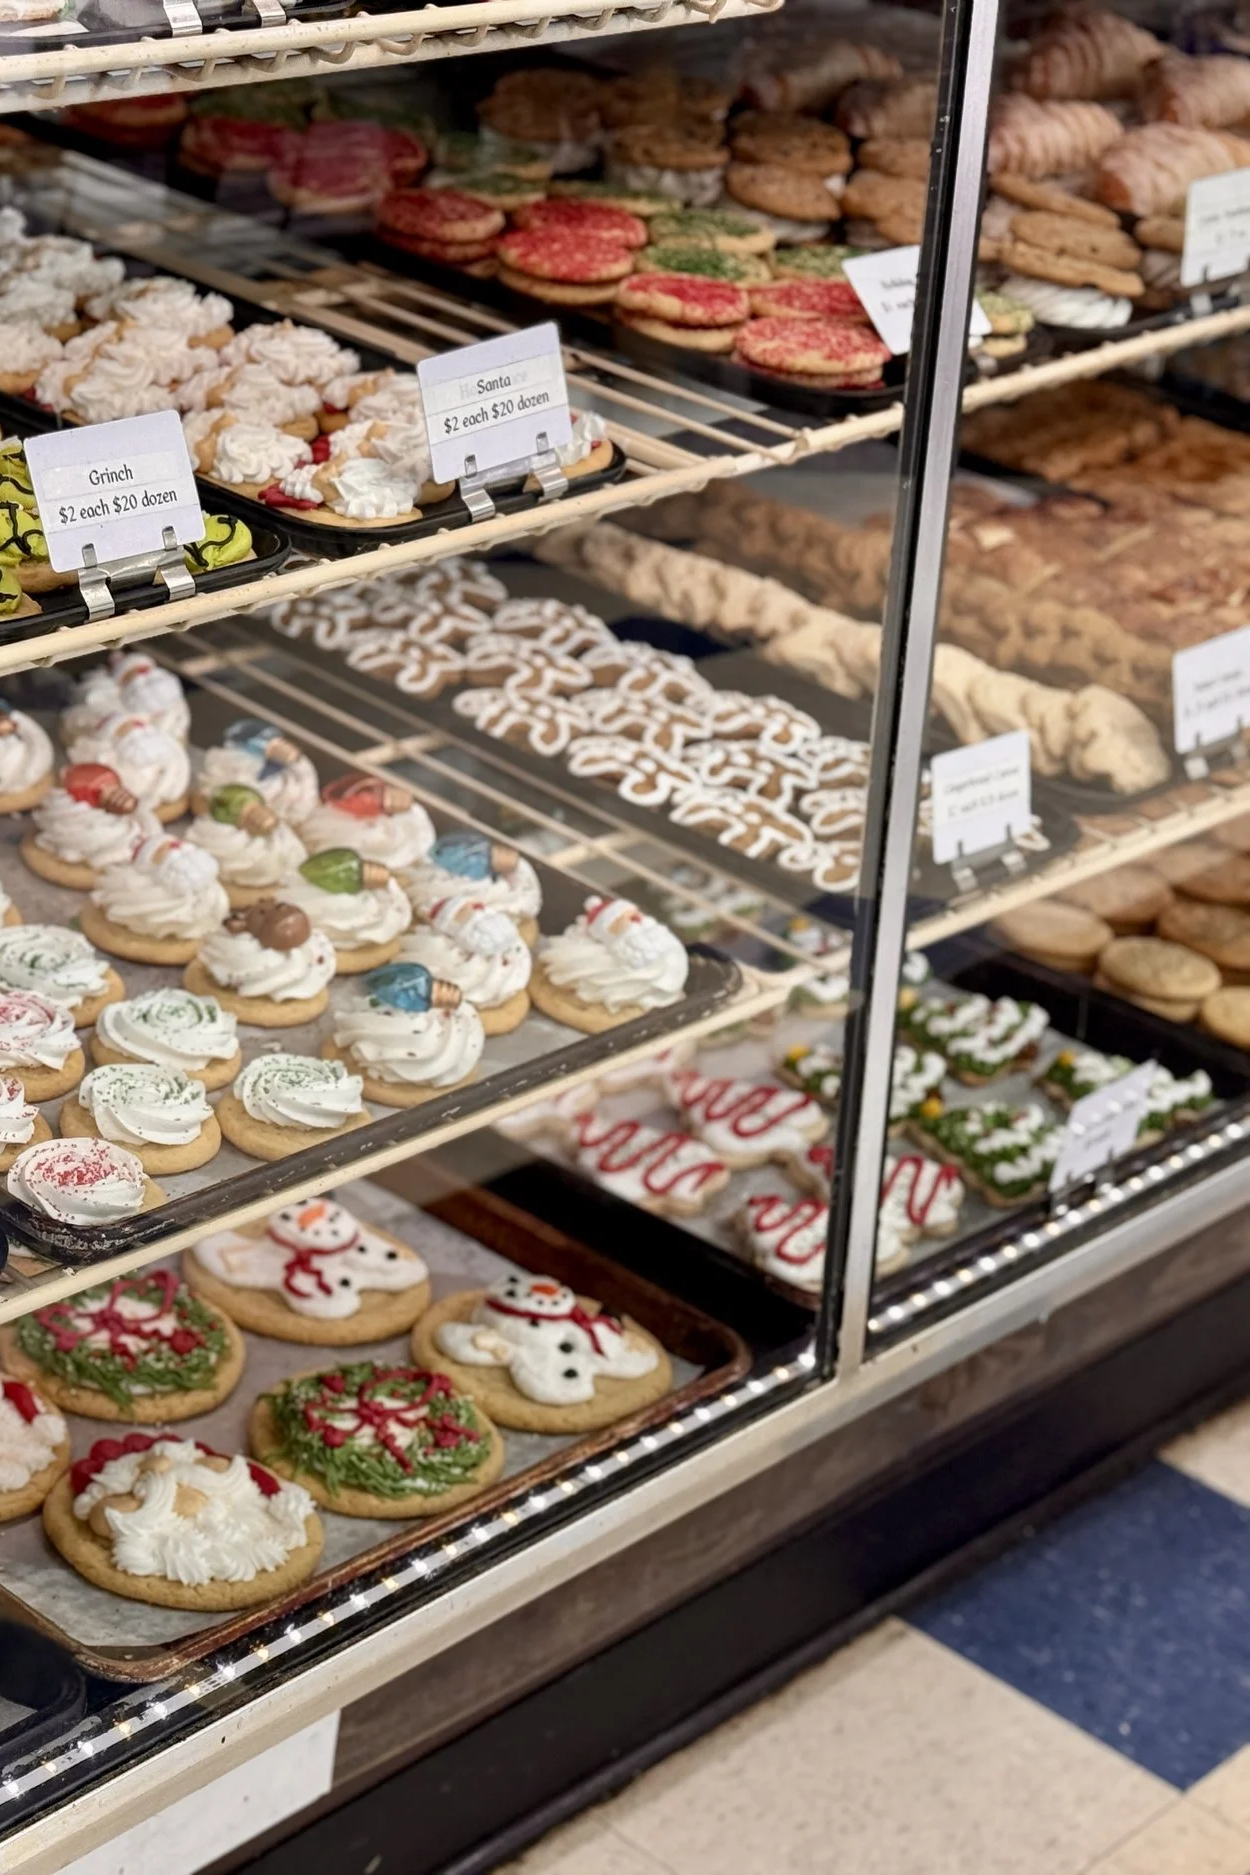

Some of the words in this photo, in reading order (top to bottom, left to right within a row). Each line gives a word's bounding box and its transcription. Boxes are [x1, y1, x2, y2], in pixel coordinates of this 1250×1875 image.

[477, 376, 511, 394] Santa
[444, 413, 459, 434] $2
[462, 407, 489, 427] each
[491, 401, 514, 420] $20
[518, 391, 549, 411] dozen
[89, 464, 133, 486] Grinch
[59, 505, 76, 525] $2
[80, 498, 110, 519] each
[113, 494, 138, 514] $20
[141, 489, 177, 507] dozen
